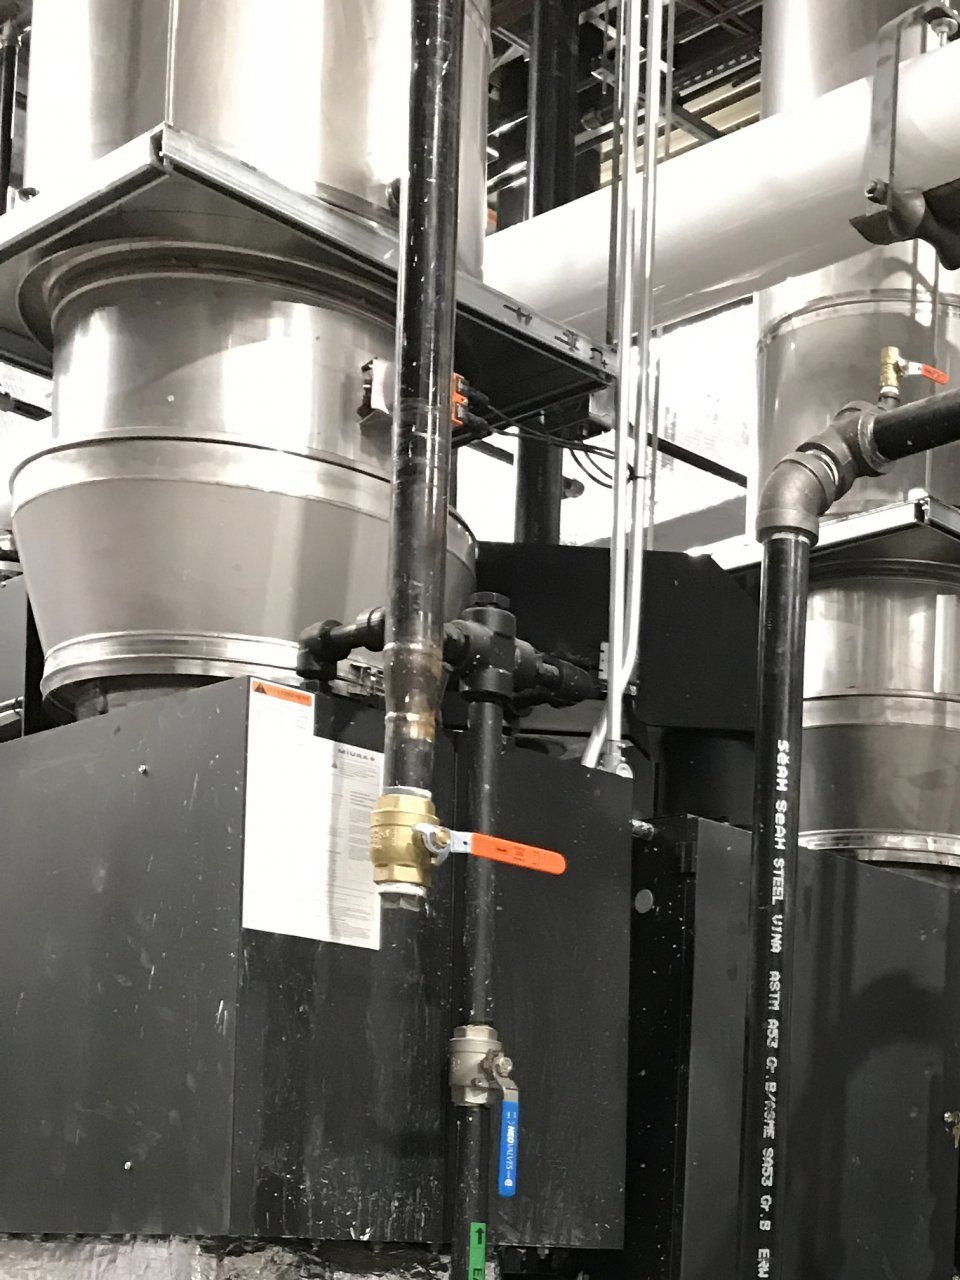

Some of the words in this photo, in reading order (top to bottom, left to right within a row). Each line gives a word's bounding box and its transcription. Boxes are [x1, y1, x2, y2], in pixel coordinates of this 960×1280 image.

[771, 857, 785, 905] STEEL
[770, 914, 783, 953] VINA
[768, 970, 781, 1011] ASTM
[766, 1018, 779, 1049] A53
[761, 1147, 774, 1187] SA53
[757, 1248, 770, 1279] ERW
